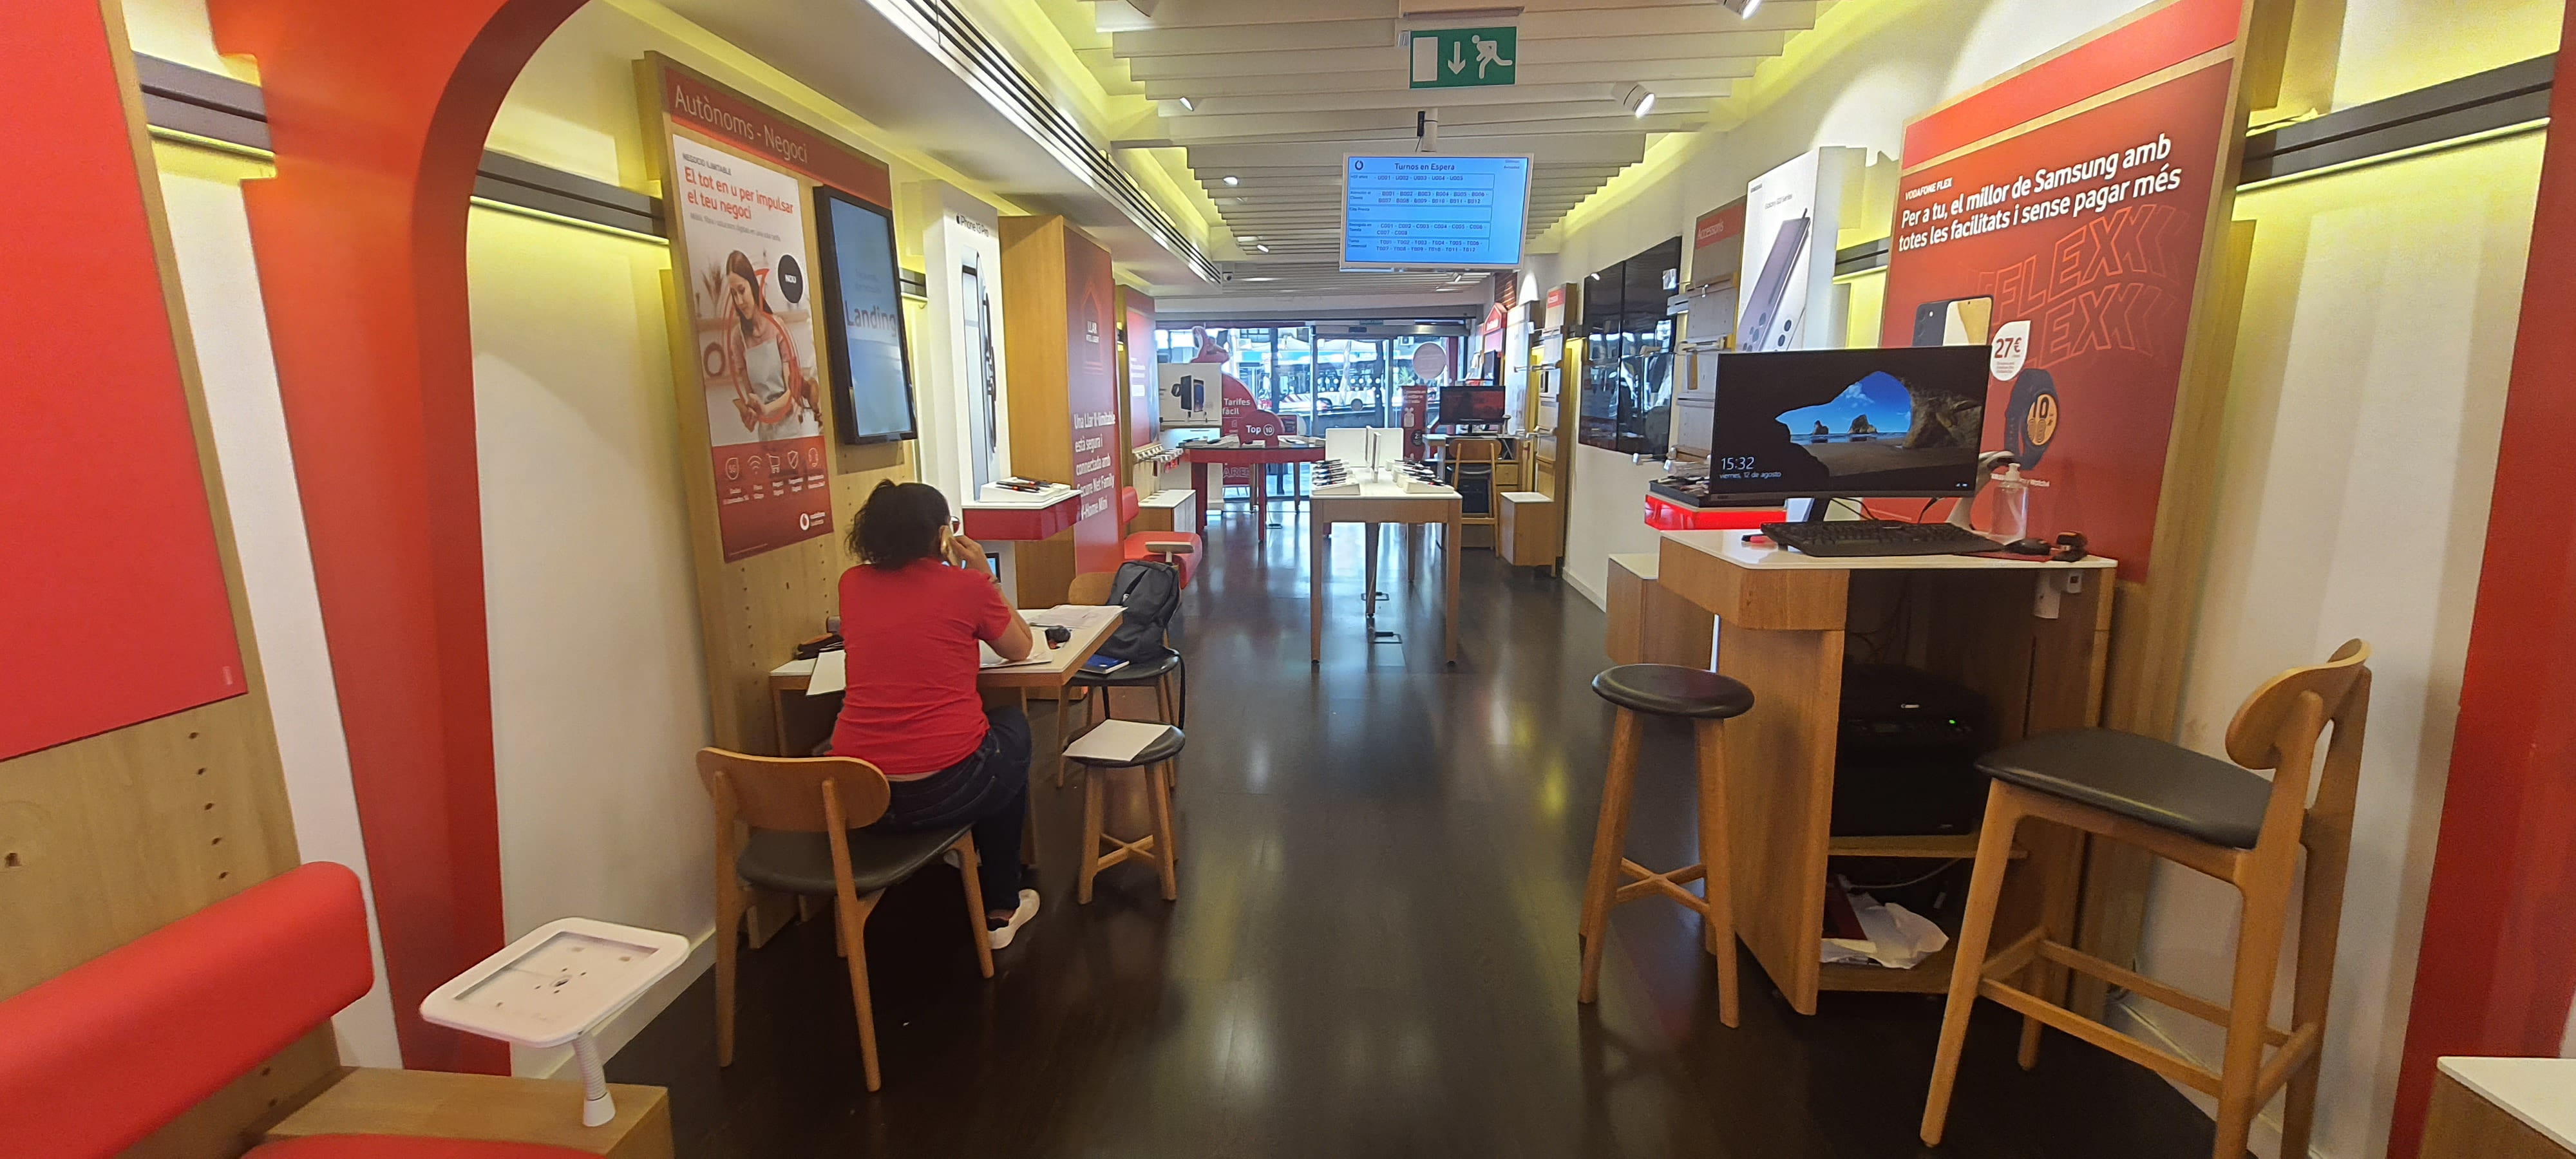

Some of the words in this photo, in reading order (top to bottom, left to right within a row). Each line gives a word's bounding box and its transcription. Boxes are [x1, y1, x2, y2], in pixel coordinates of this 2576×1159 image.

[675, 86, 754, 140] Autònoms
[765, 127, 808, 164] Negoci
[1431, 163, 1455, 171] Espera
[685, 167, 696, 185] El
[699, 173, 714, 190] tot
[716, 180, 729, 194] en
[731, 185, 737, 196] u
[740, 187, 754, 202] per
[757, 189, 793, 214] impulsar
[1901, 209, 1920, 229] Per
[1922, 209, 1930, 223] a
[1932, 200, 1948, 221] tu,
[1951, 194, 1964, 215] el
[1966, 183, 2010, 212] millor
[2012, 174, 2031, 199] de
[2033, 151, 2119, 193] Samsung
[2122, 133, 2172, 169] amb
[1904, 181, 1936, 201] VODAFONE
[1937, 177, 1953, 193] FLEX
[688, 189, 699, 205] el
[701, 193, 717, 210] teu
[721, 200, 752, 220] negoci
[1899, 229, 1927, 252] totes
[1930, 222, 1948, 245] les
[1951, 209, 2011, 241] facilitats
[2013, 205, 2018, 226] i
[2022, 199, 2069, 224] sense
[2073, 184, 2128, 217] pagar
[2133, 163, 2182, 199] més
[845, 300, 897, 337] Landing
[1224, 397, 1251, 406] Tarifes
[1245, 424, 1261, 435] Top
[1086, 437, 1101, 453] segura
[1721, 457, 1755, 470] 15:32
